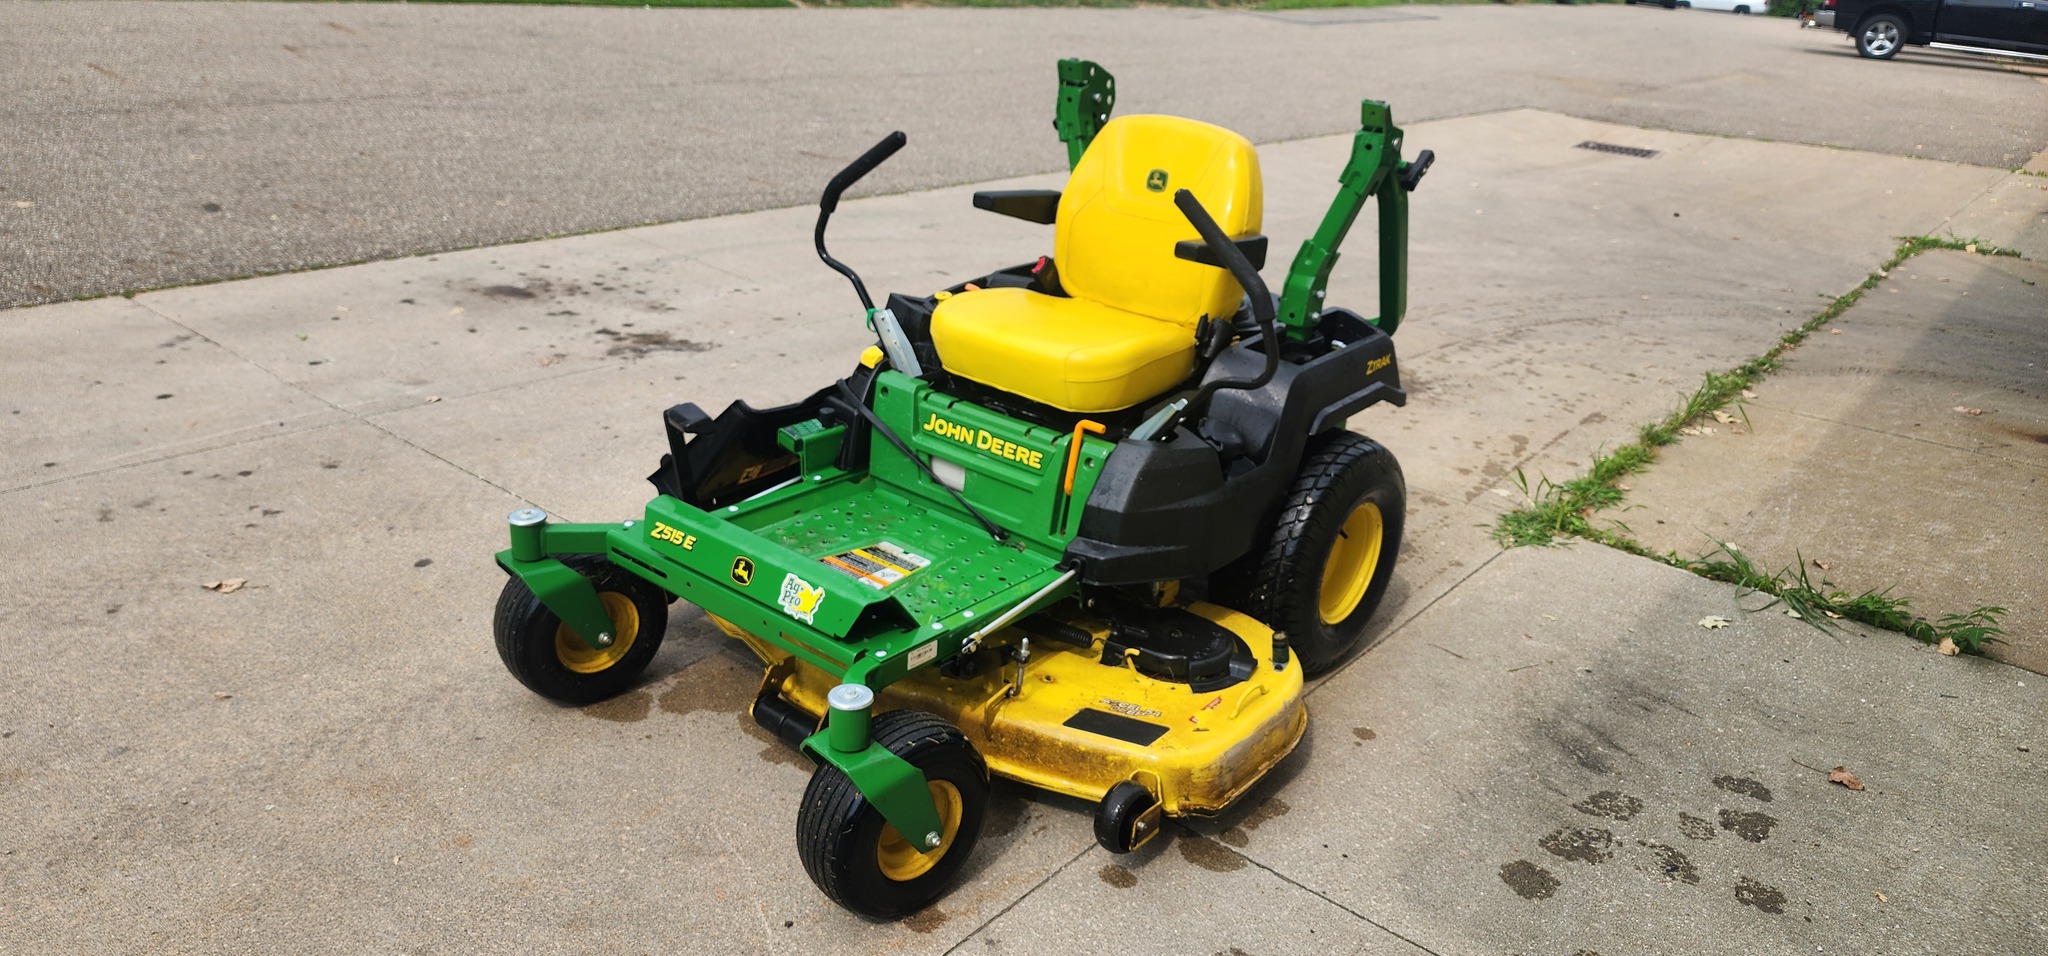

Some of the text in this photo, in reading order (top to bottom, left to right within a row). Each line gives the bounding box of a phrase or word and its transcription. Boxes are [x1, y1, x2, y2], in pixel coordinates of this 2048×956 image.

[1365, 353, 1392, 375] ZTRAK
[923, 413, 1043, 469] JOHN DEERE
[650, 521, 698, 551] Z515 E
[783, 590, 801, 606] Pro
